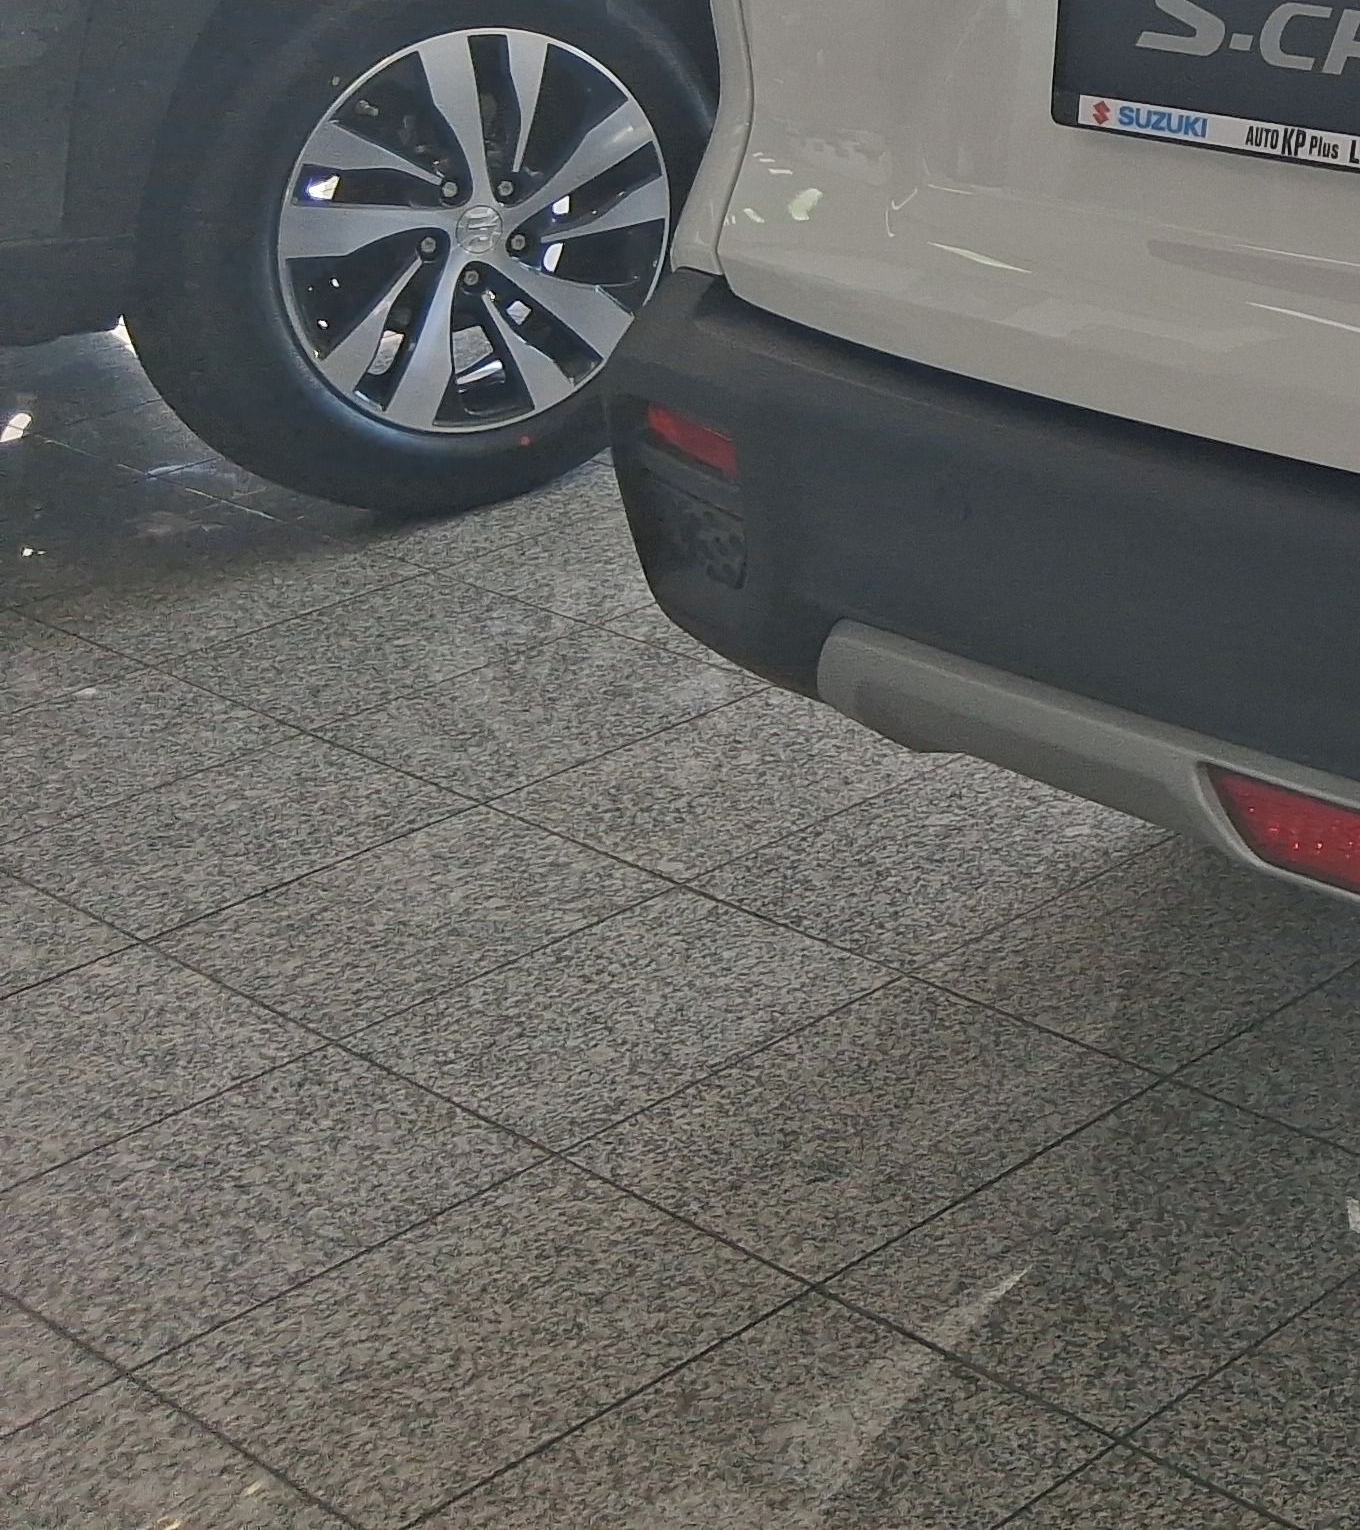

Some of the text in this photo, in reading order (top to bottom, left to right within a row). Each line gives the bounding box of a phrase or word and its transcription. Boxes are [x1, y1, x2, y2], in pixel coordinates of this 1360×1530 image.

[1117, 105, 1208, 139] SUZUKI
[1245, 125, 1279, 151] AUTO
[1280, 127, 1307, 158] KP
[1308, 136, 1340, 160] Plus
